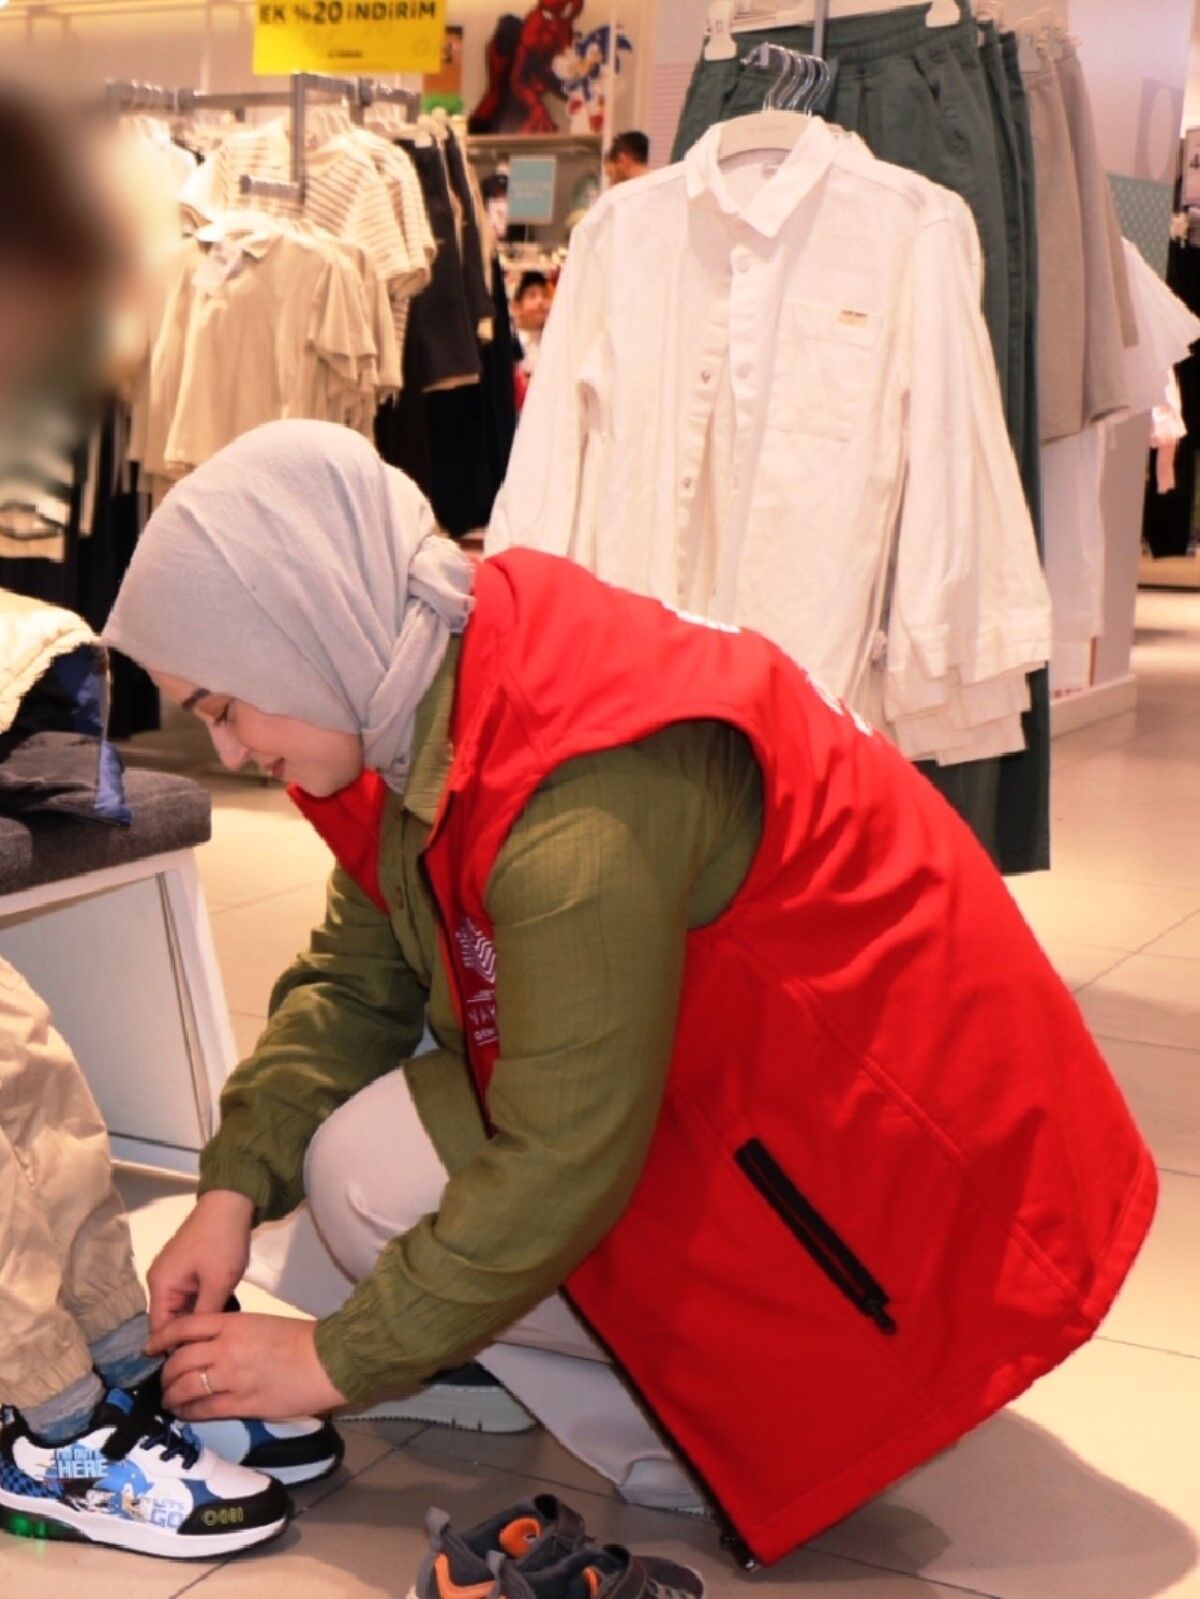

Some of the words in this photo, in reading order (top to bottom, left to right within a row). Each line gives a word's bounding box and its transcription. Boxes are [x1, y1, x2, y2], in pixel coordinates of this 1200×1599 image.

[259, 4, 286, 24] EK
[293, 0, 344, 24] %20
[58, 1460, 109, 1479] HERE
